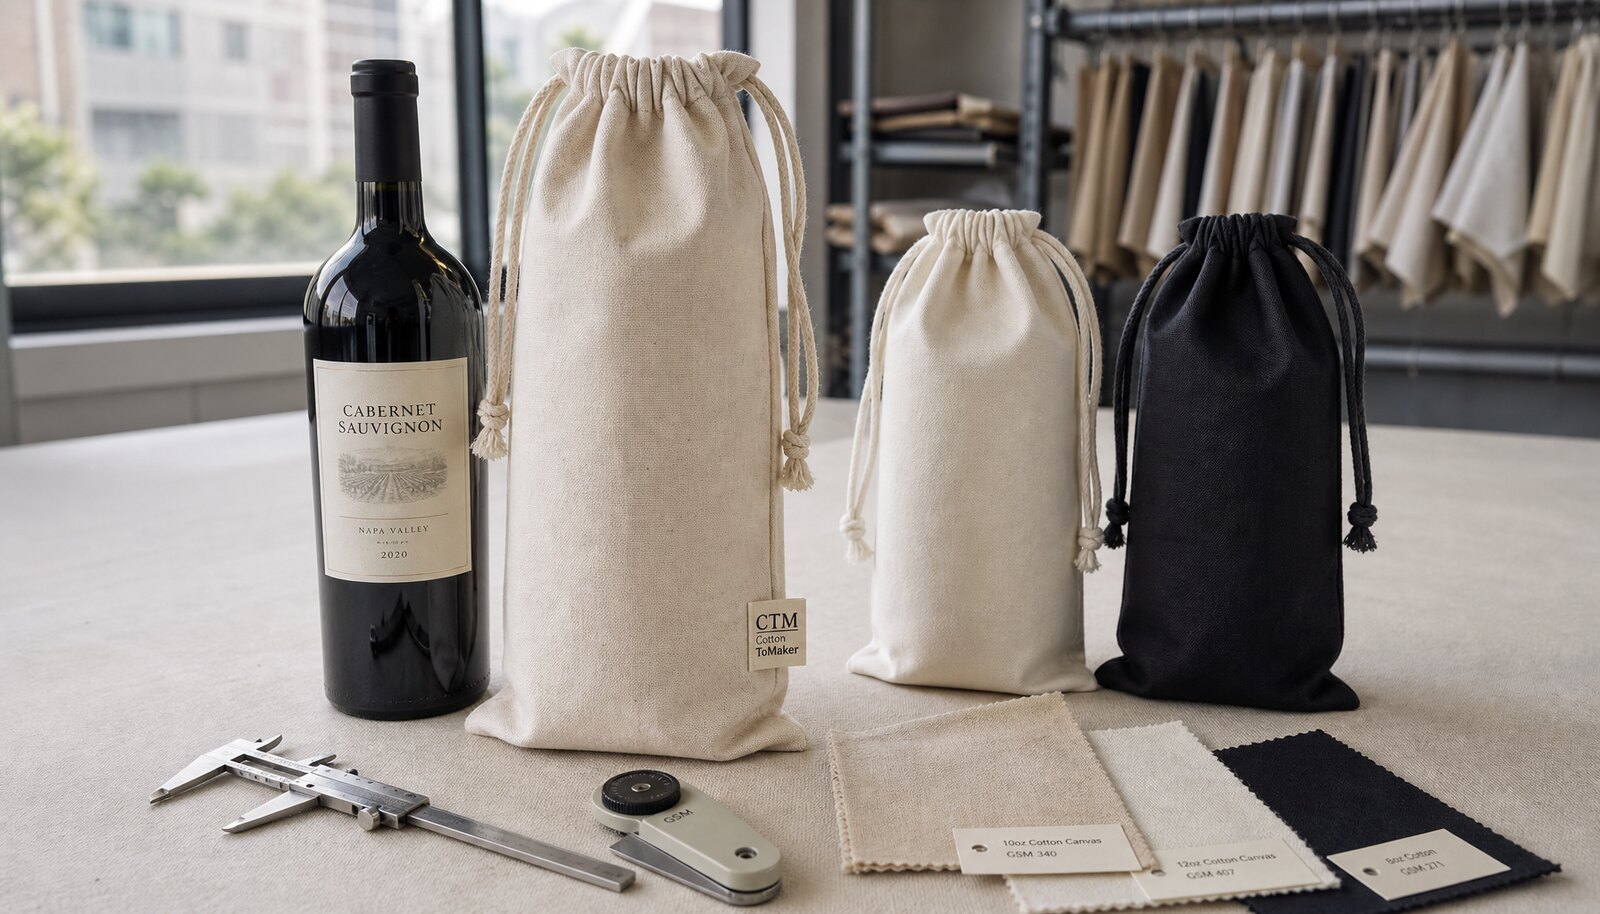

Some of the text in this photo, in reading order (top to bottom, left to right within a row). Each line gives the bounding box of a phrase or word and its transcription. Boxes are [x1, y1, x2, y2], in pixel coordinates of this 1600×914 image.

[343, 403, 436, 418] CABERNET
[338, 419, 442, 435] SAUVIGNON
[358, 525, 429, 535] NAPA VALLEY
[381, 550, 408, 559] 2020
[756, 612, 798, 630] CTM
[755, 635, 786, 645] Cotton
[755, 645, 799, 657] ToMaker
[663, 809, 694, 824] GSM
[1003, 839, 1027, 847] 10oz
[1006, 850, 1058, 858] GSM 340
[1403, 849, 1437, 861] Cotton
[1177, 853, 1277, 868] 12oz Cotton Canvas
[1186, 868, 1235, 879] GSM 407
[1400, 864, 1426, 875] GSM
